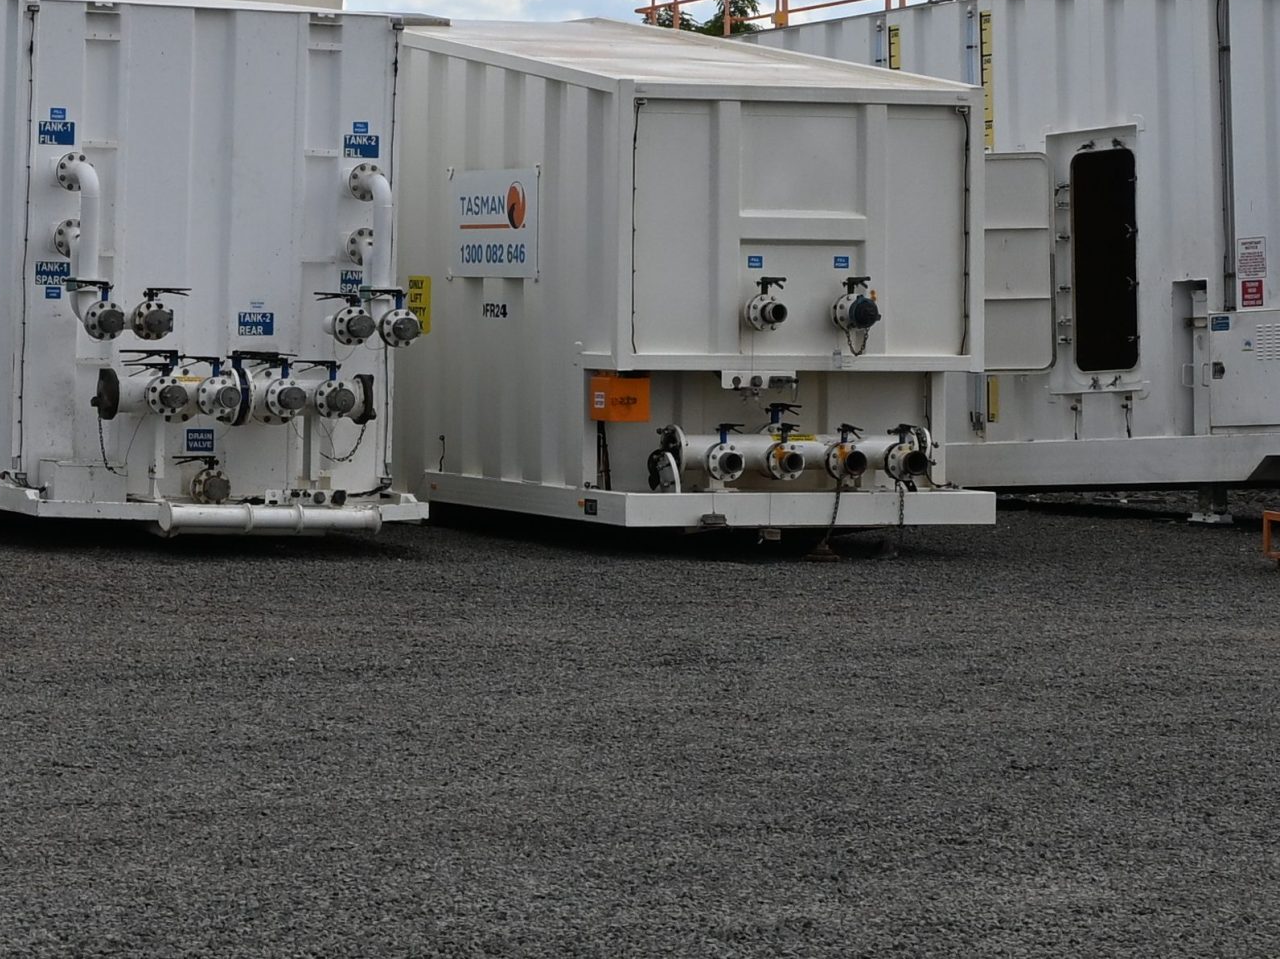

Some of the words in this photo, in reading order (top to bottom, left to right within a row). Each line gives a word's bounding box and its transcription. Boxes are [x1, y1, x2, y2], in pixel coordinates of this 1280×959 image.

[39, 121, 71, 132] TANK-1
[40, 134, 58, 145] FILL
[345, 135, 377, 146] TANK-2
[345, 148, 363, 158] FILL
[460, 195, 505, 216] TASMAN
[460, 244, 483, 264] 1300
[485, 243, 504, 264] 082
[507, 243, 525, 264] 646
[35, 261, 68, 273] TANK-1
[341, 283, 361, 293] SPA
[240, 313, 272, 324] TANK-2
[240, 325, 263, 335] REAR
[188, 432, 213, 440] DRAIN
[188, 440, 212, 449] VALVE
